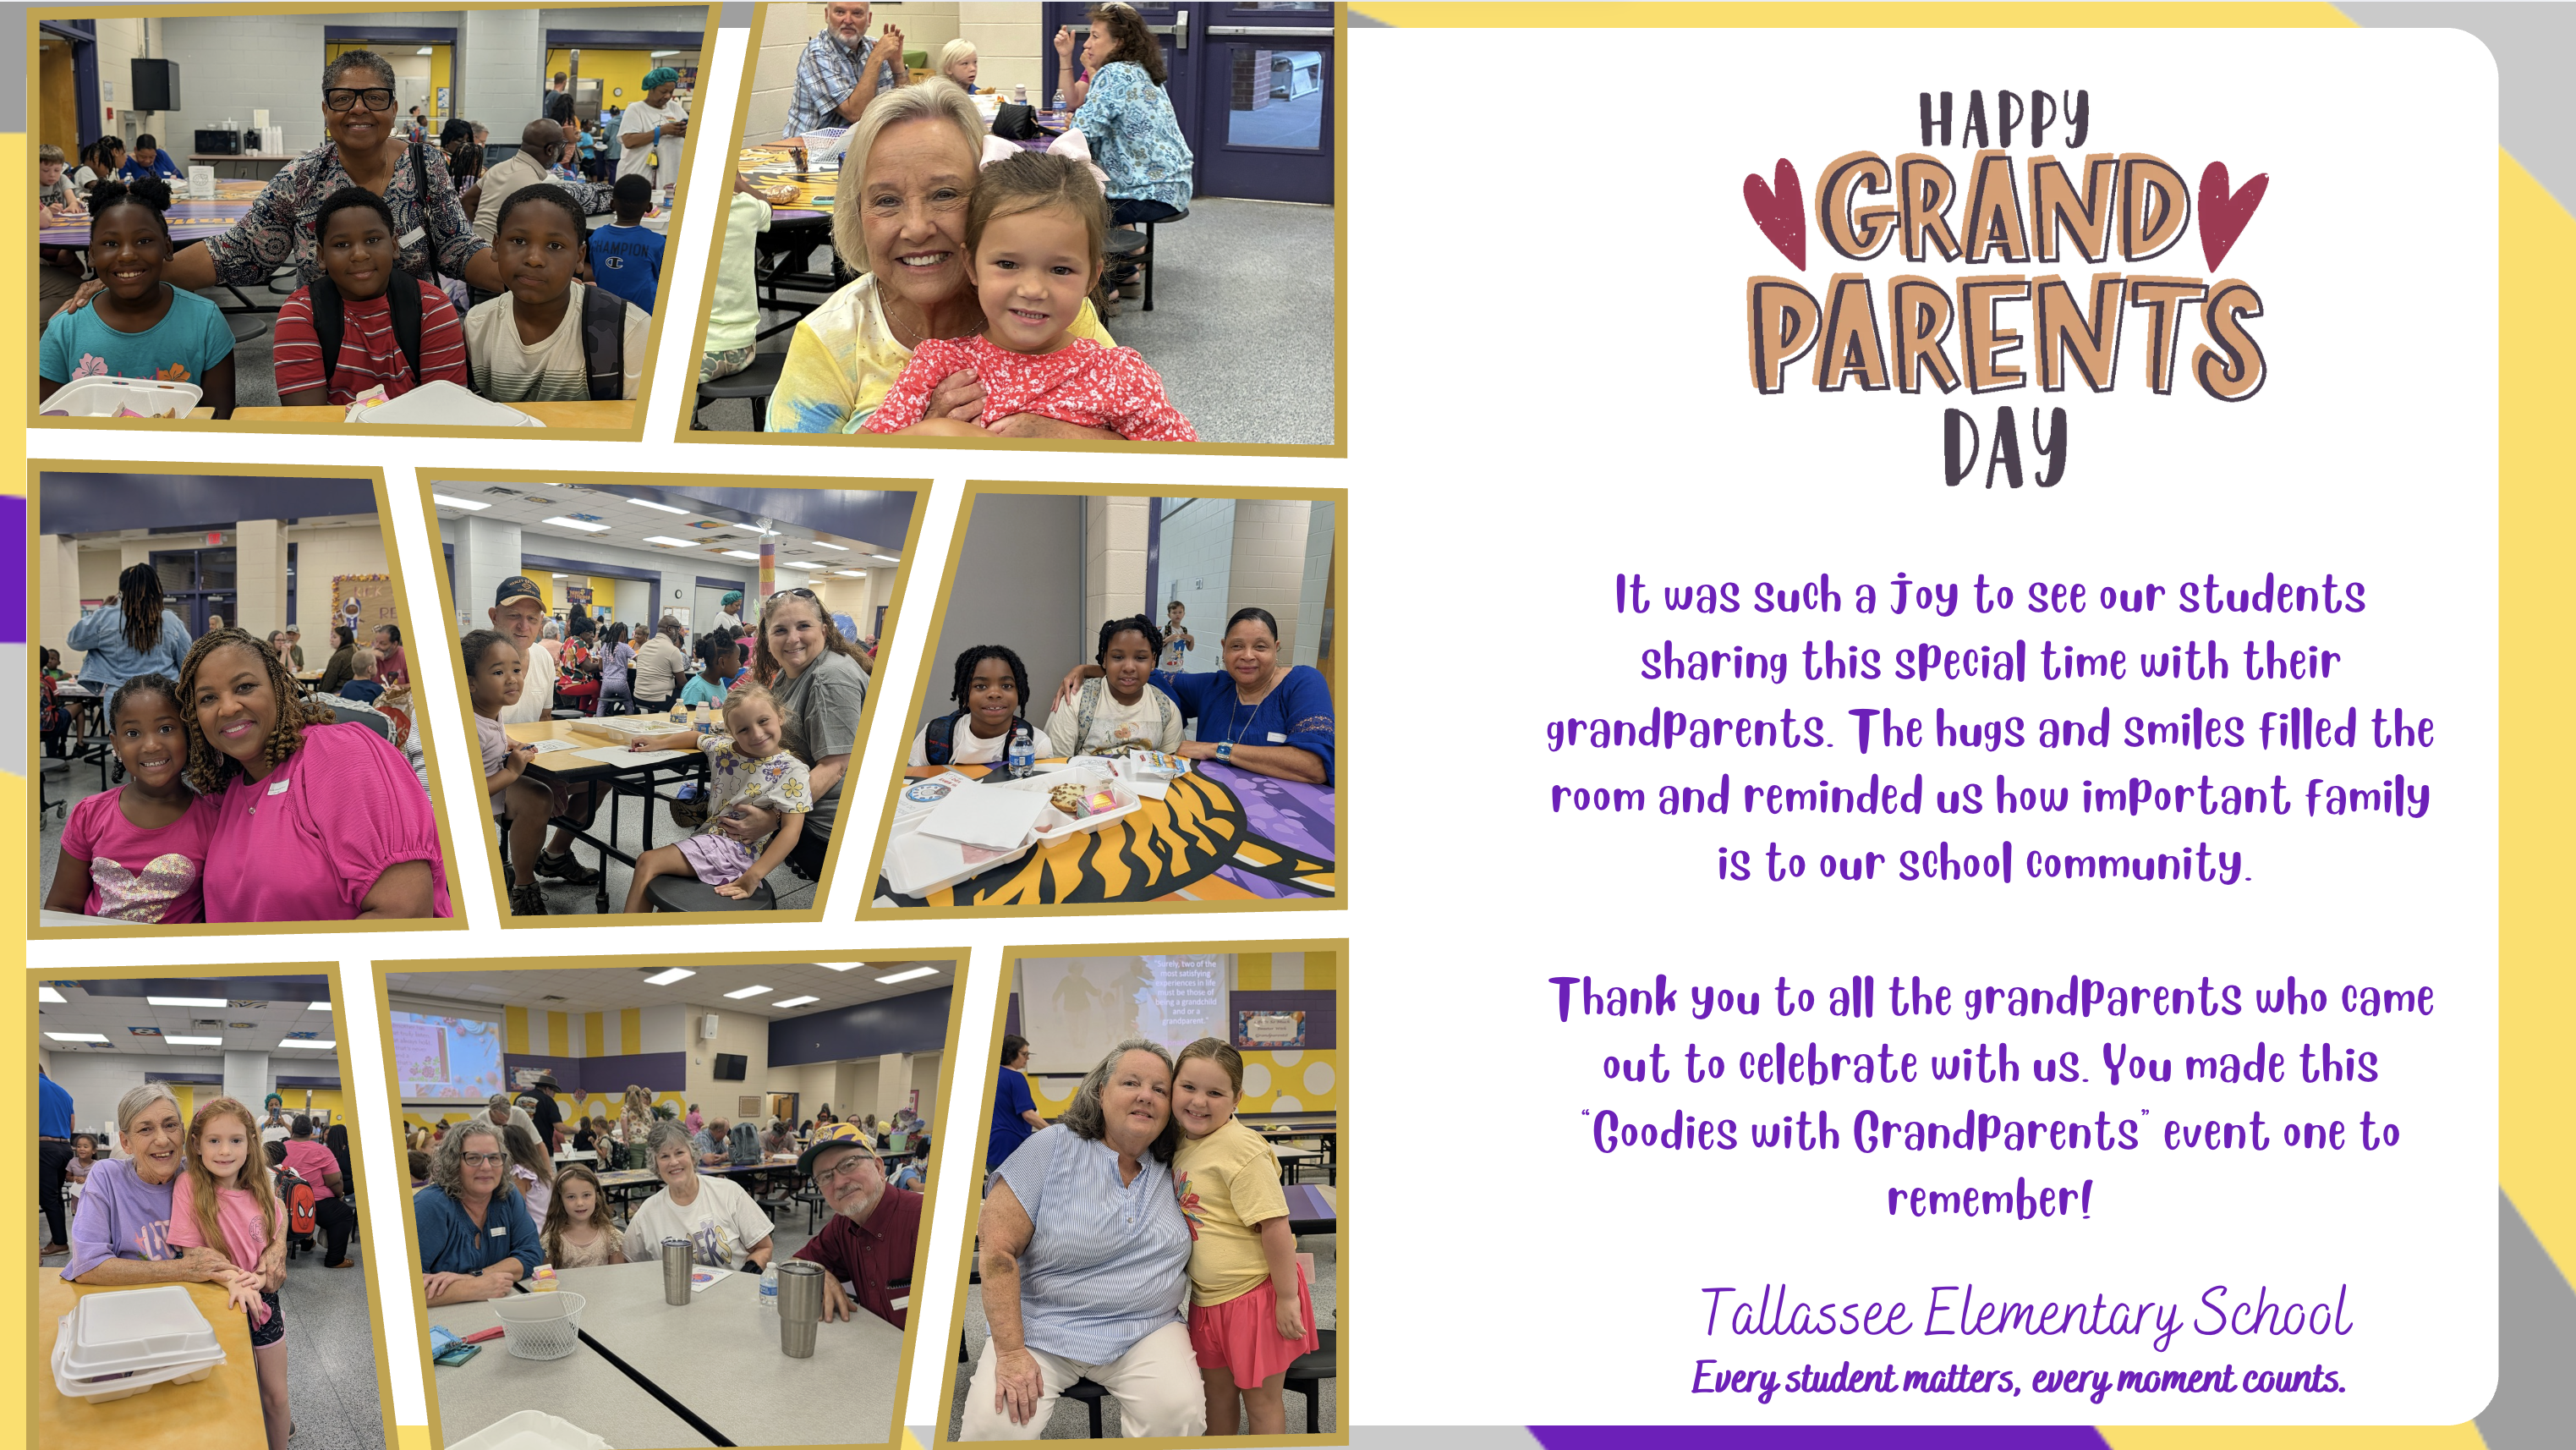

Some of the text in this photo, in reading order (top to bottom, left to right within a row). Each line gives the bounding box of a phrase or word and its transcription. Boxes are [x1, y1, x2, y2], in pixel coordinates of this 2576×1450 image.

[593, 239, 649, 258] CHAMPION
[354, 585, 382, 597] KICK
[1179, 969, 1210, 978] satisfying
[1181, 998, 1216, 1007] grandchild
[1162, 1017, 1209, 1026] grandparent."
